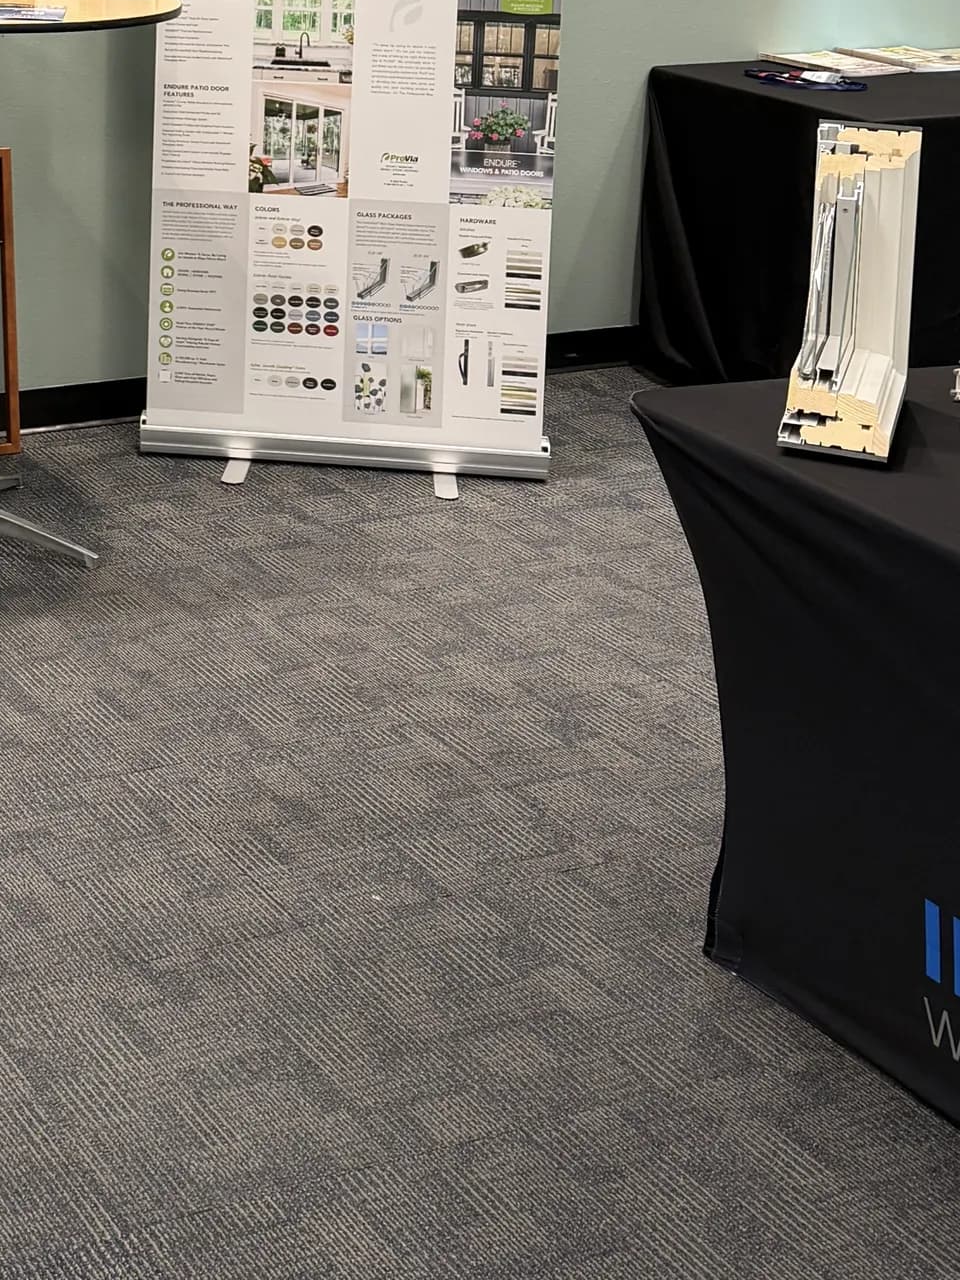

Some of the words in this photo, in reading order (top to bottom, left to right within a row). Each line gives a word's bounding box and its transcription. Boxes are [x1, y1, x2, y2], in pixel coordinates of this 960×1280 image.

[390, 154, 419, 162] ProVia
[483, 158, 518, 168] ENDURE
[459, 166, 493, 174] WINDOWS
[460, 217, 497, 225] HARDWARE
